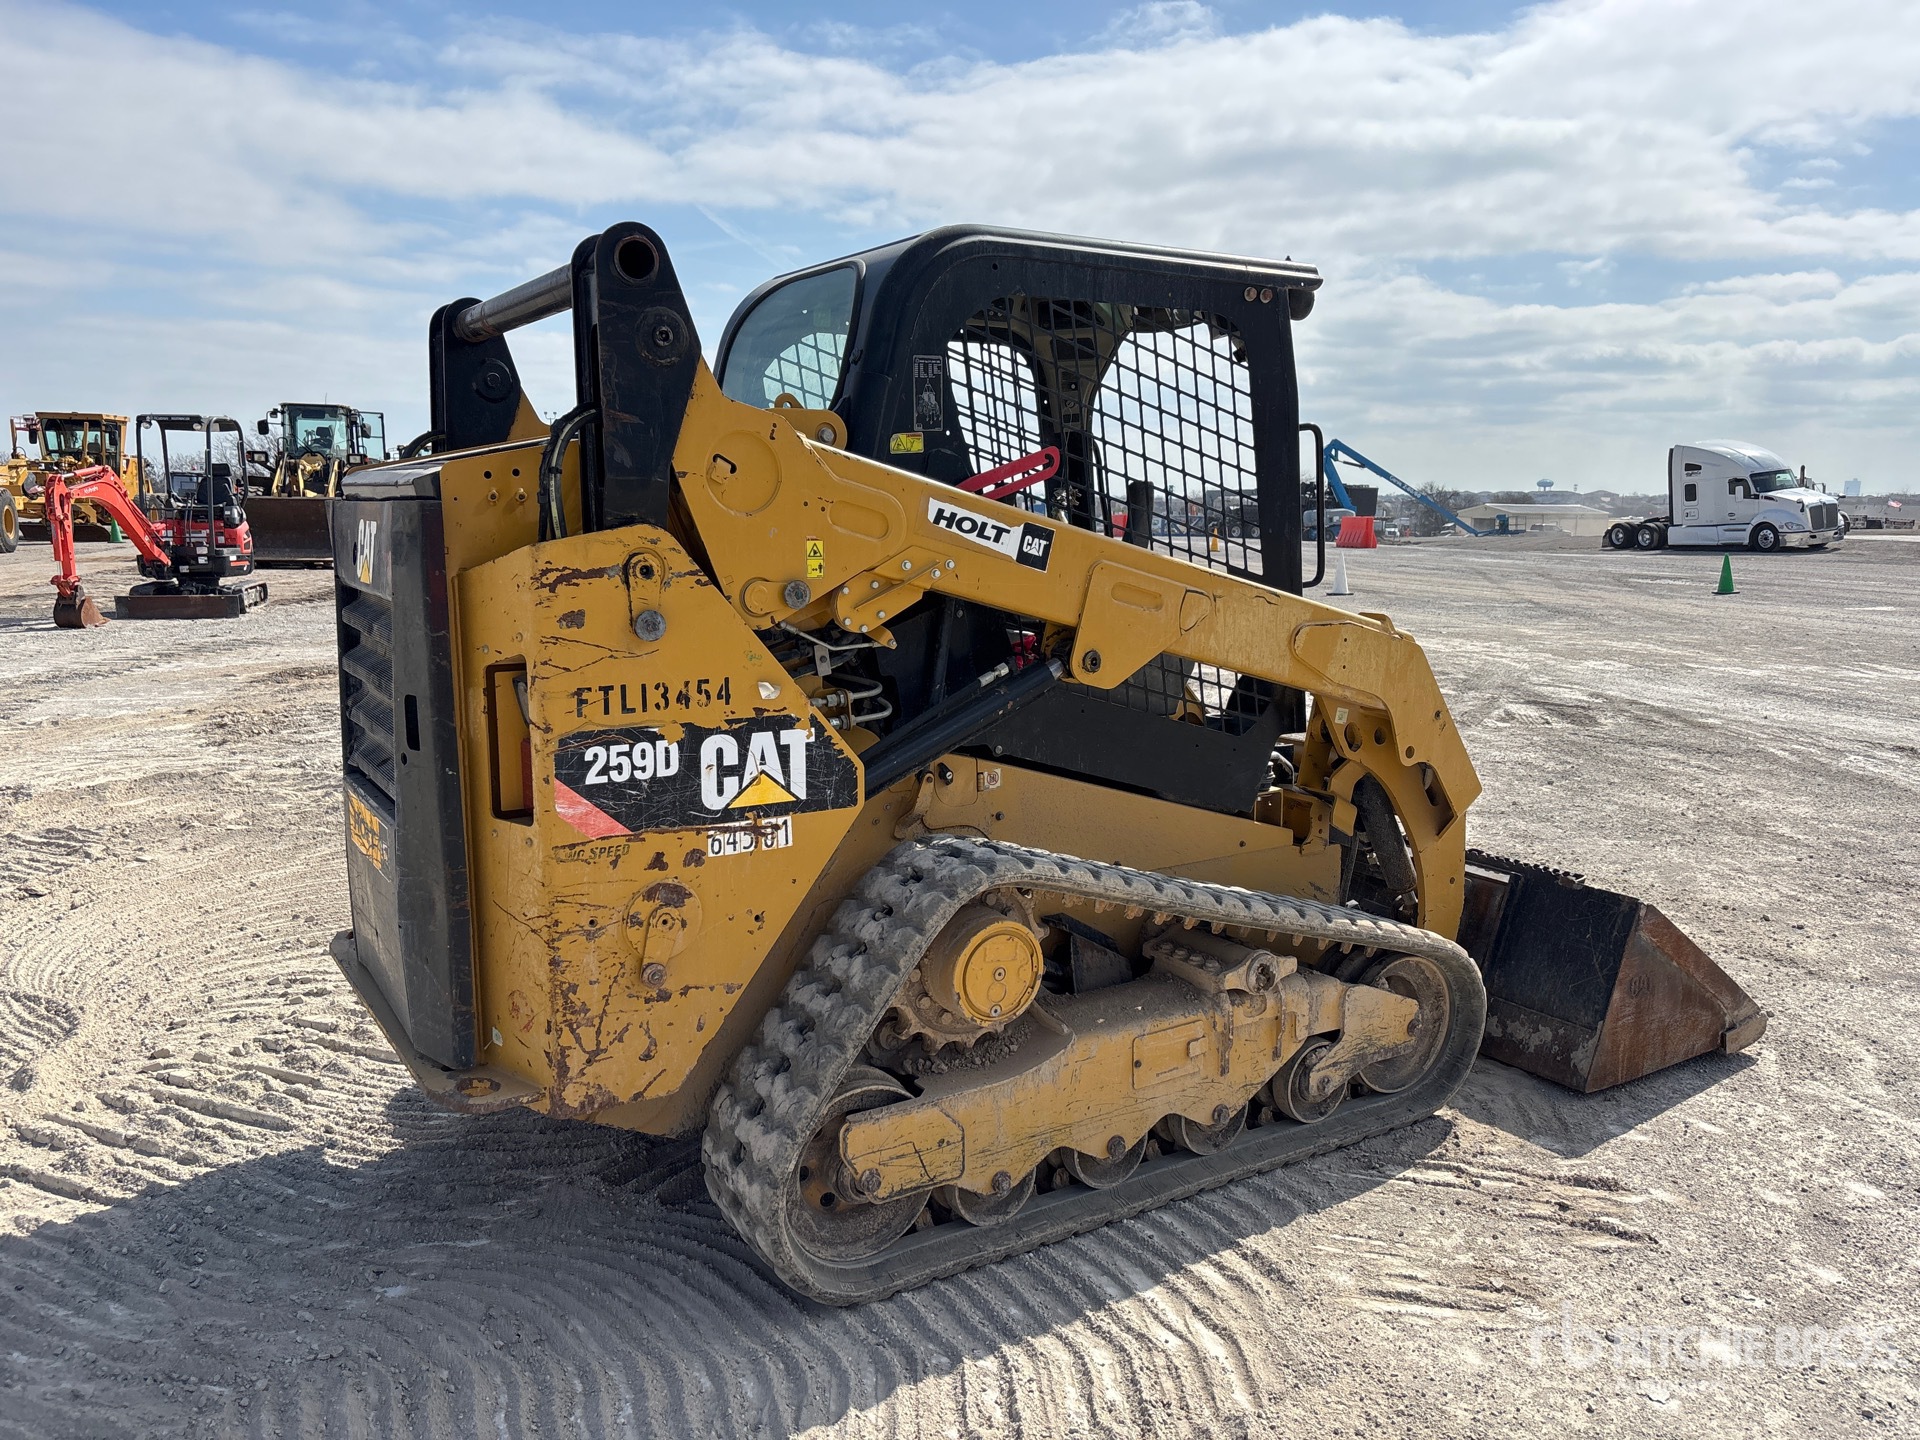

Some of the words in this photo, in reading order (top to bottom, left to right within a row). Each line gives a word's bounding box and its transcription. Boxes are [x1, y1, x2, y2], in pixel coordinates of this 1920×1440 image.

[357, 518, 377, 585] CAT
[932, 507, 1011, 544] HOLT
[1022, 535, 1049, 557] CAT
[584, 740, 679, 785] 259D
[700, 728, 815, 810] CAT
[588, 843, 631, 860] SPEED
